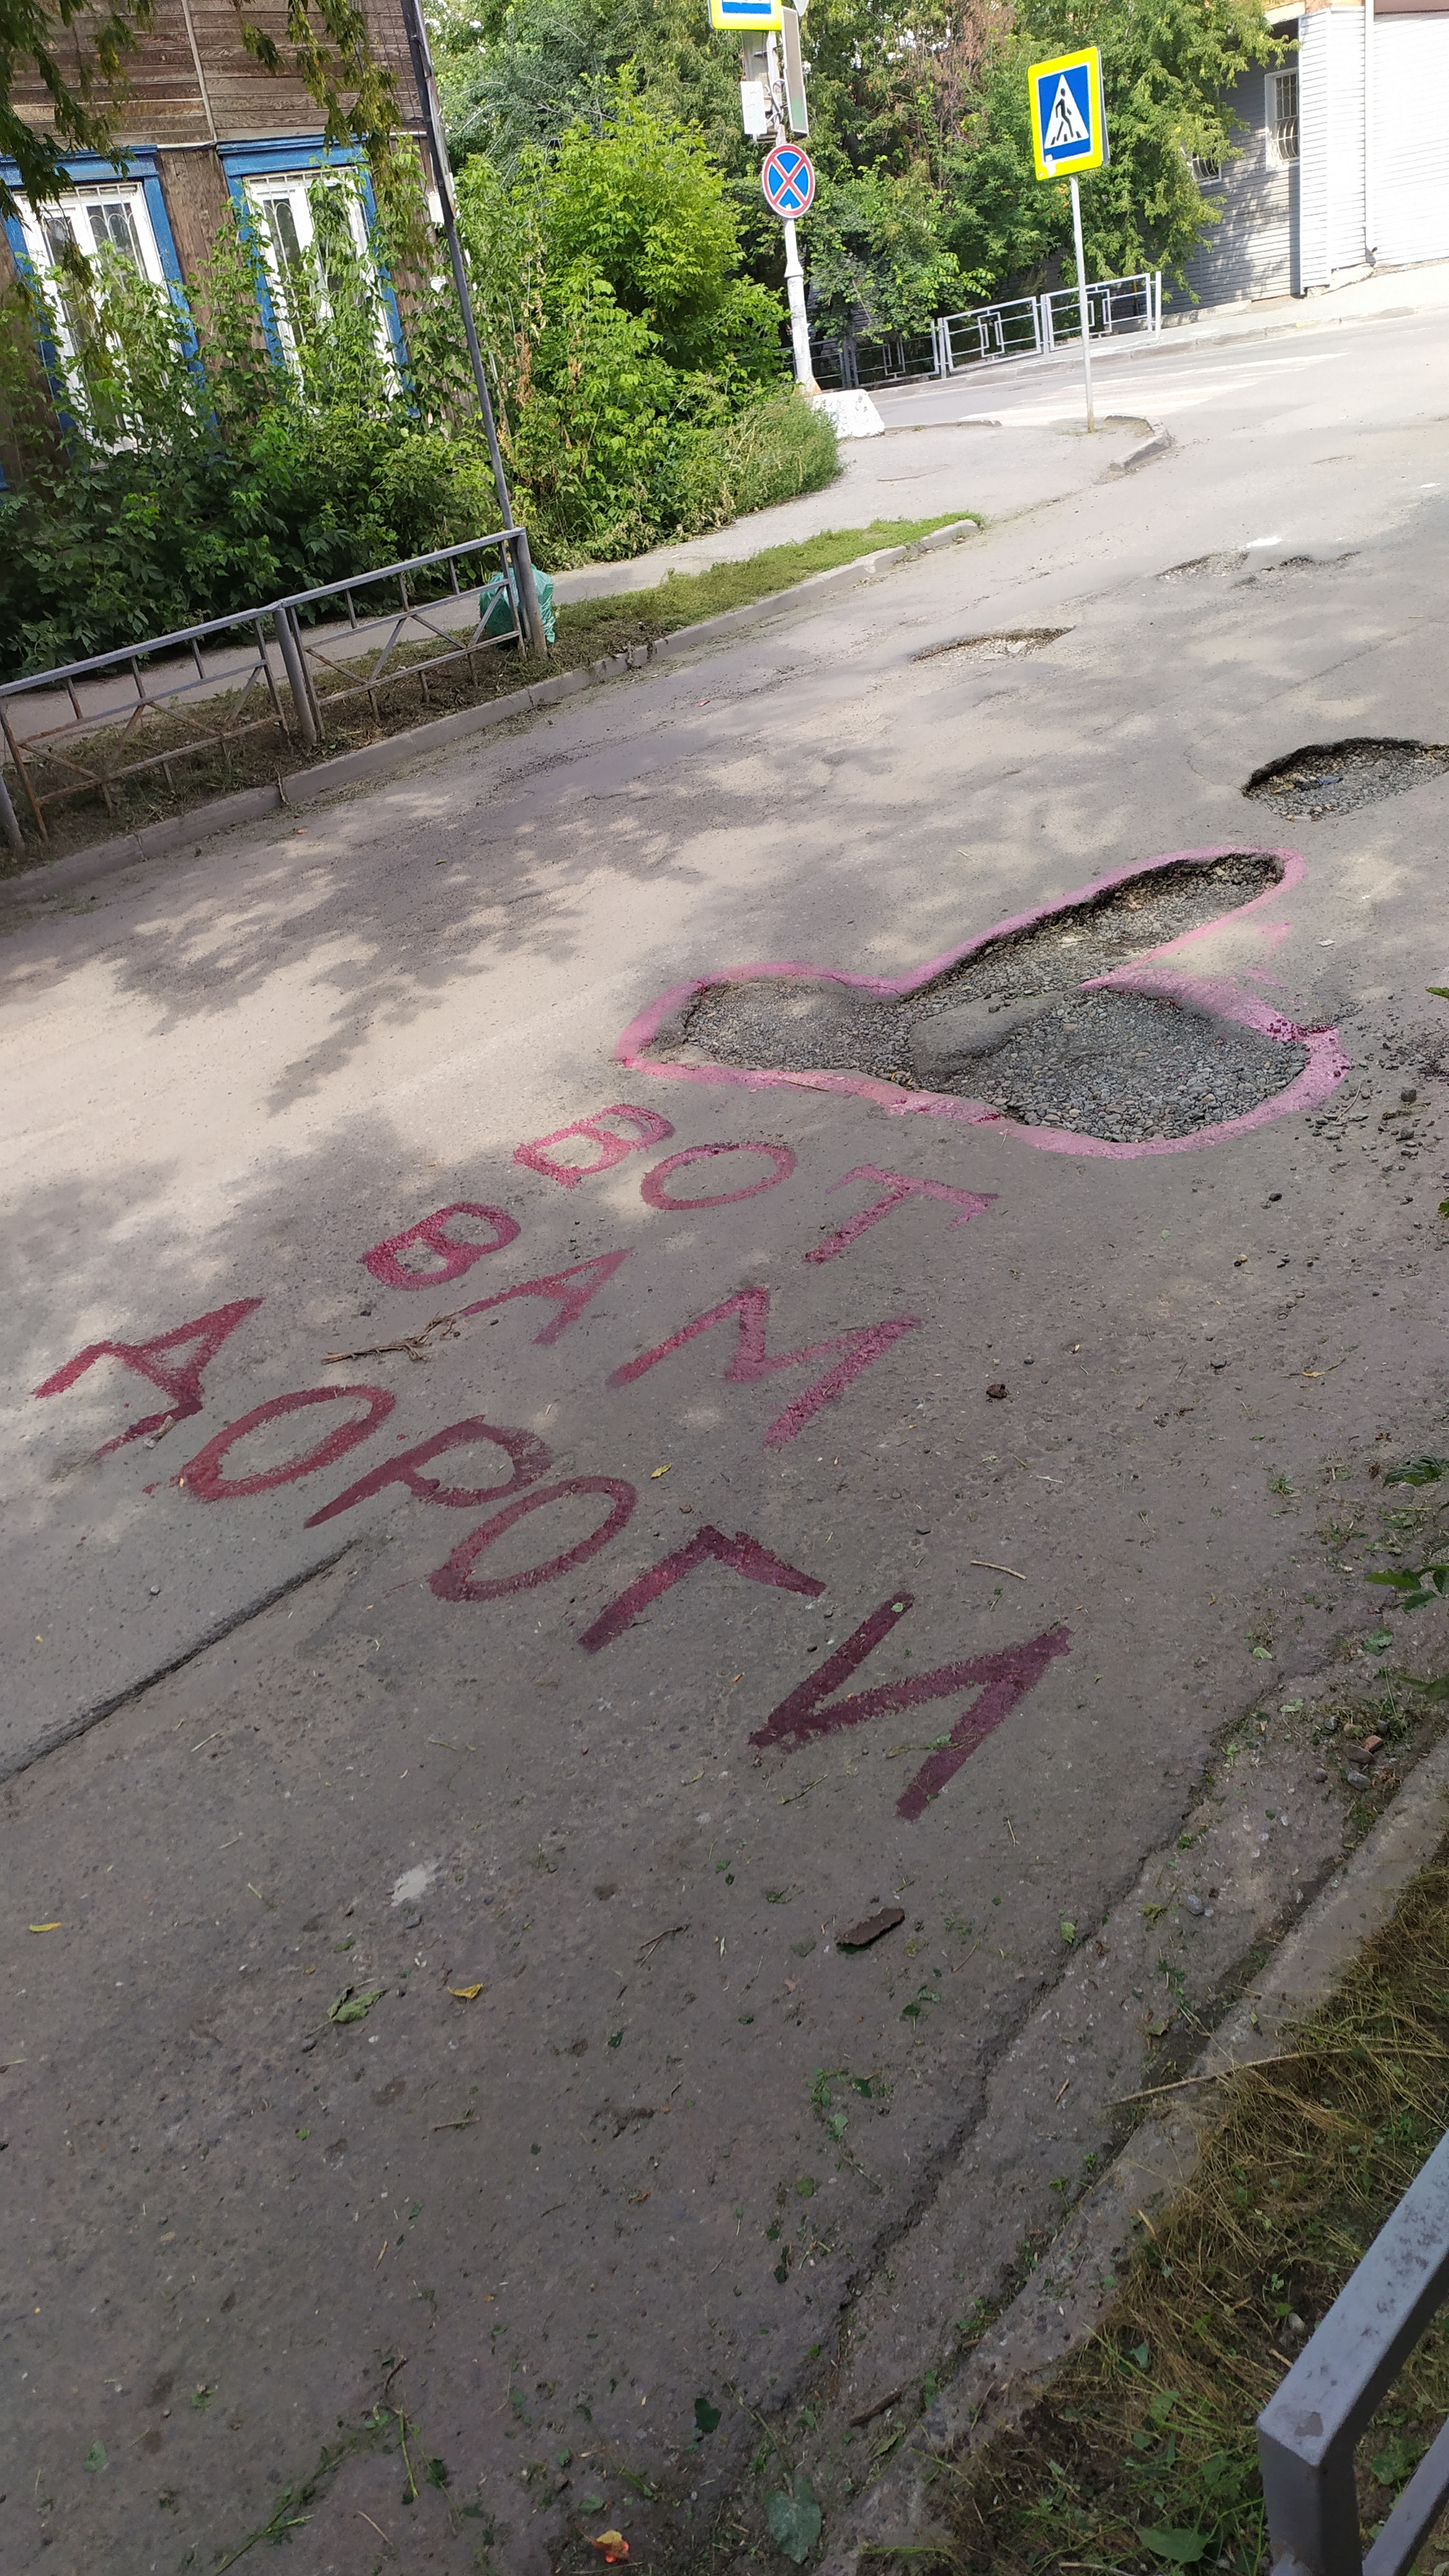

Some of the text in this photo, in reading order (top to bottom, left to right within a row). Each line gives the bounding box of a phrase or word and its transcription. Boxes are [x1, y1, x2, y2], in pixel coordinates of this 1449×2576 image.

[513, 1103, 998, 1264] ВОТ
[359, 1201, 921, 1448] ВАМ
[31, 1298, 1070, 1820] ДОРОГИ
